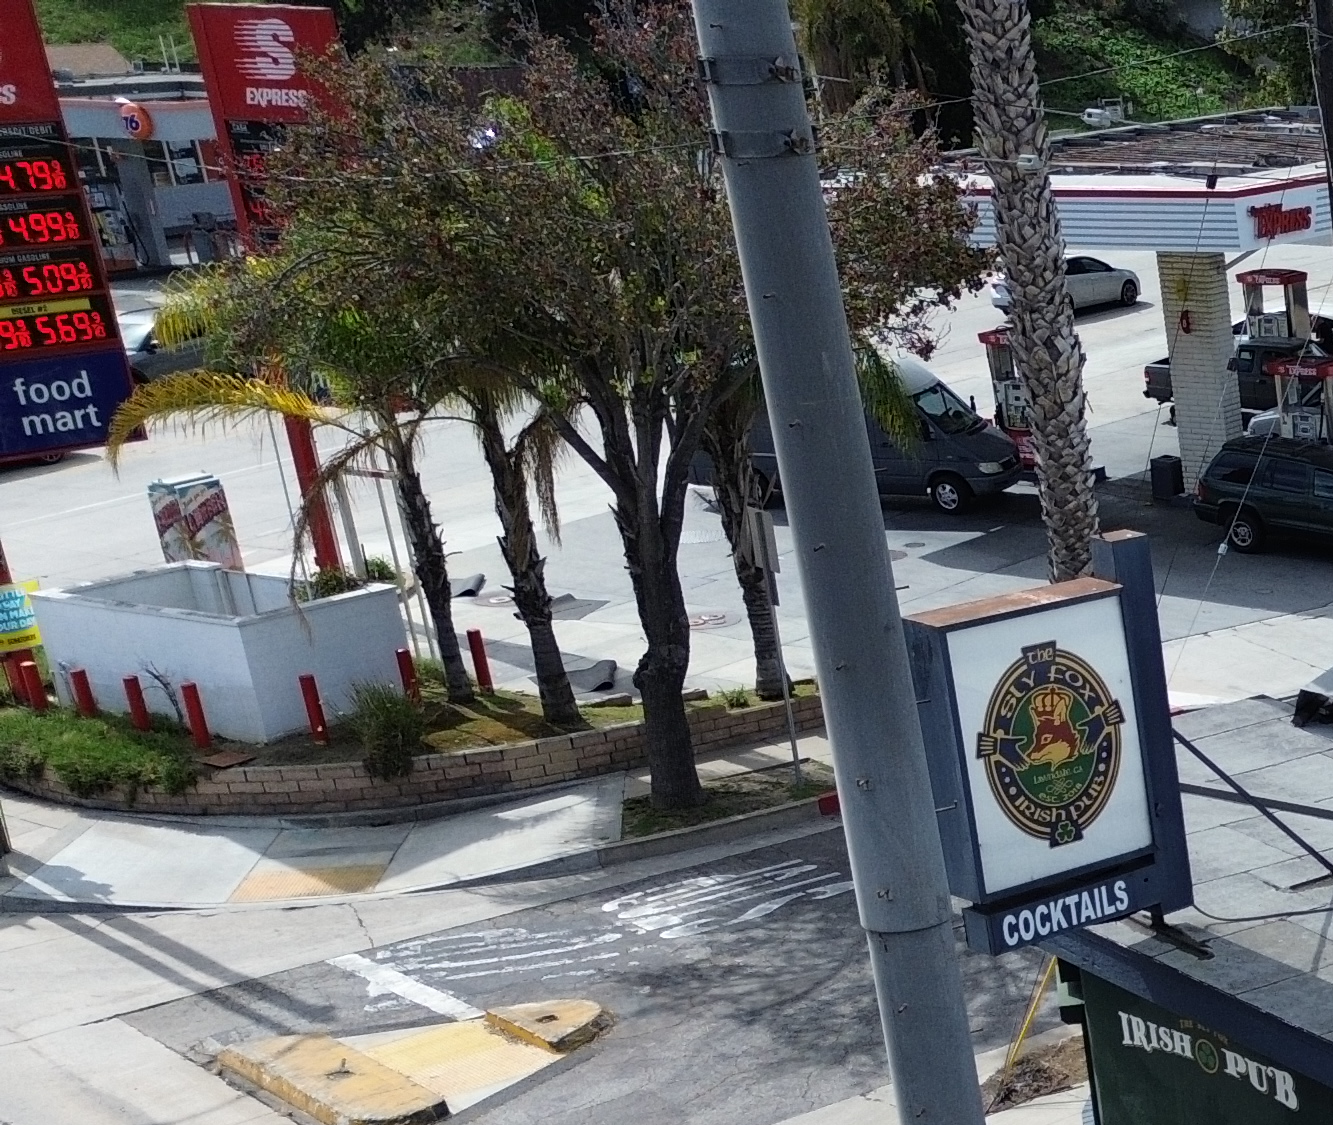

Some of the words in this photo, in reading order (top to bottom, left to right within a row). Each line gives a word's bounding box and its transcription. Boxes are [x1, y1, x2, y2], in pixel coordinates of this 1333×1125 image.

[122, 114, 140, 131] 76
[13, 369, 93, 405] food
[21, 403, 102, 436] mart
[1001, 670, 1036, 720] SLY
[1047, 664, 1096, 700] FOX
[1002, 880, 1129, 946] COCKTAILS
[1118, 1011, 1195, 1061] IRISH
[1220, 1048, 1300, 1112] PUB
